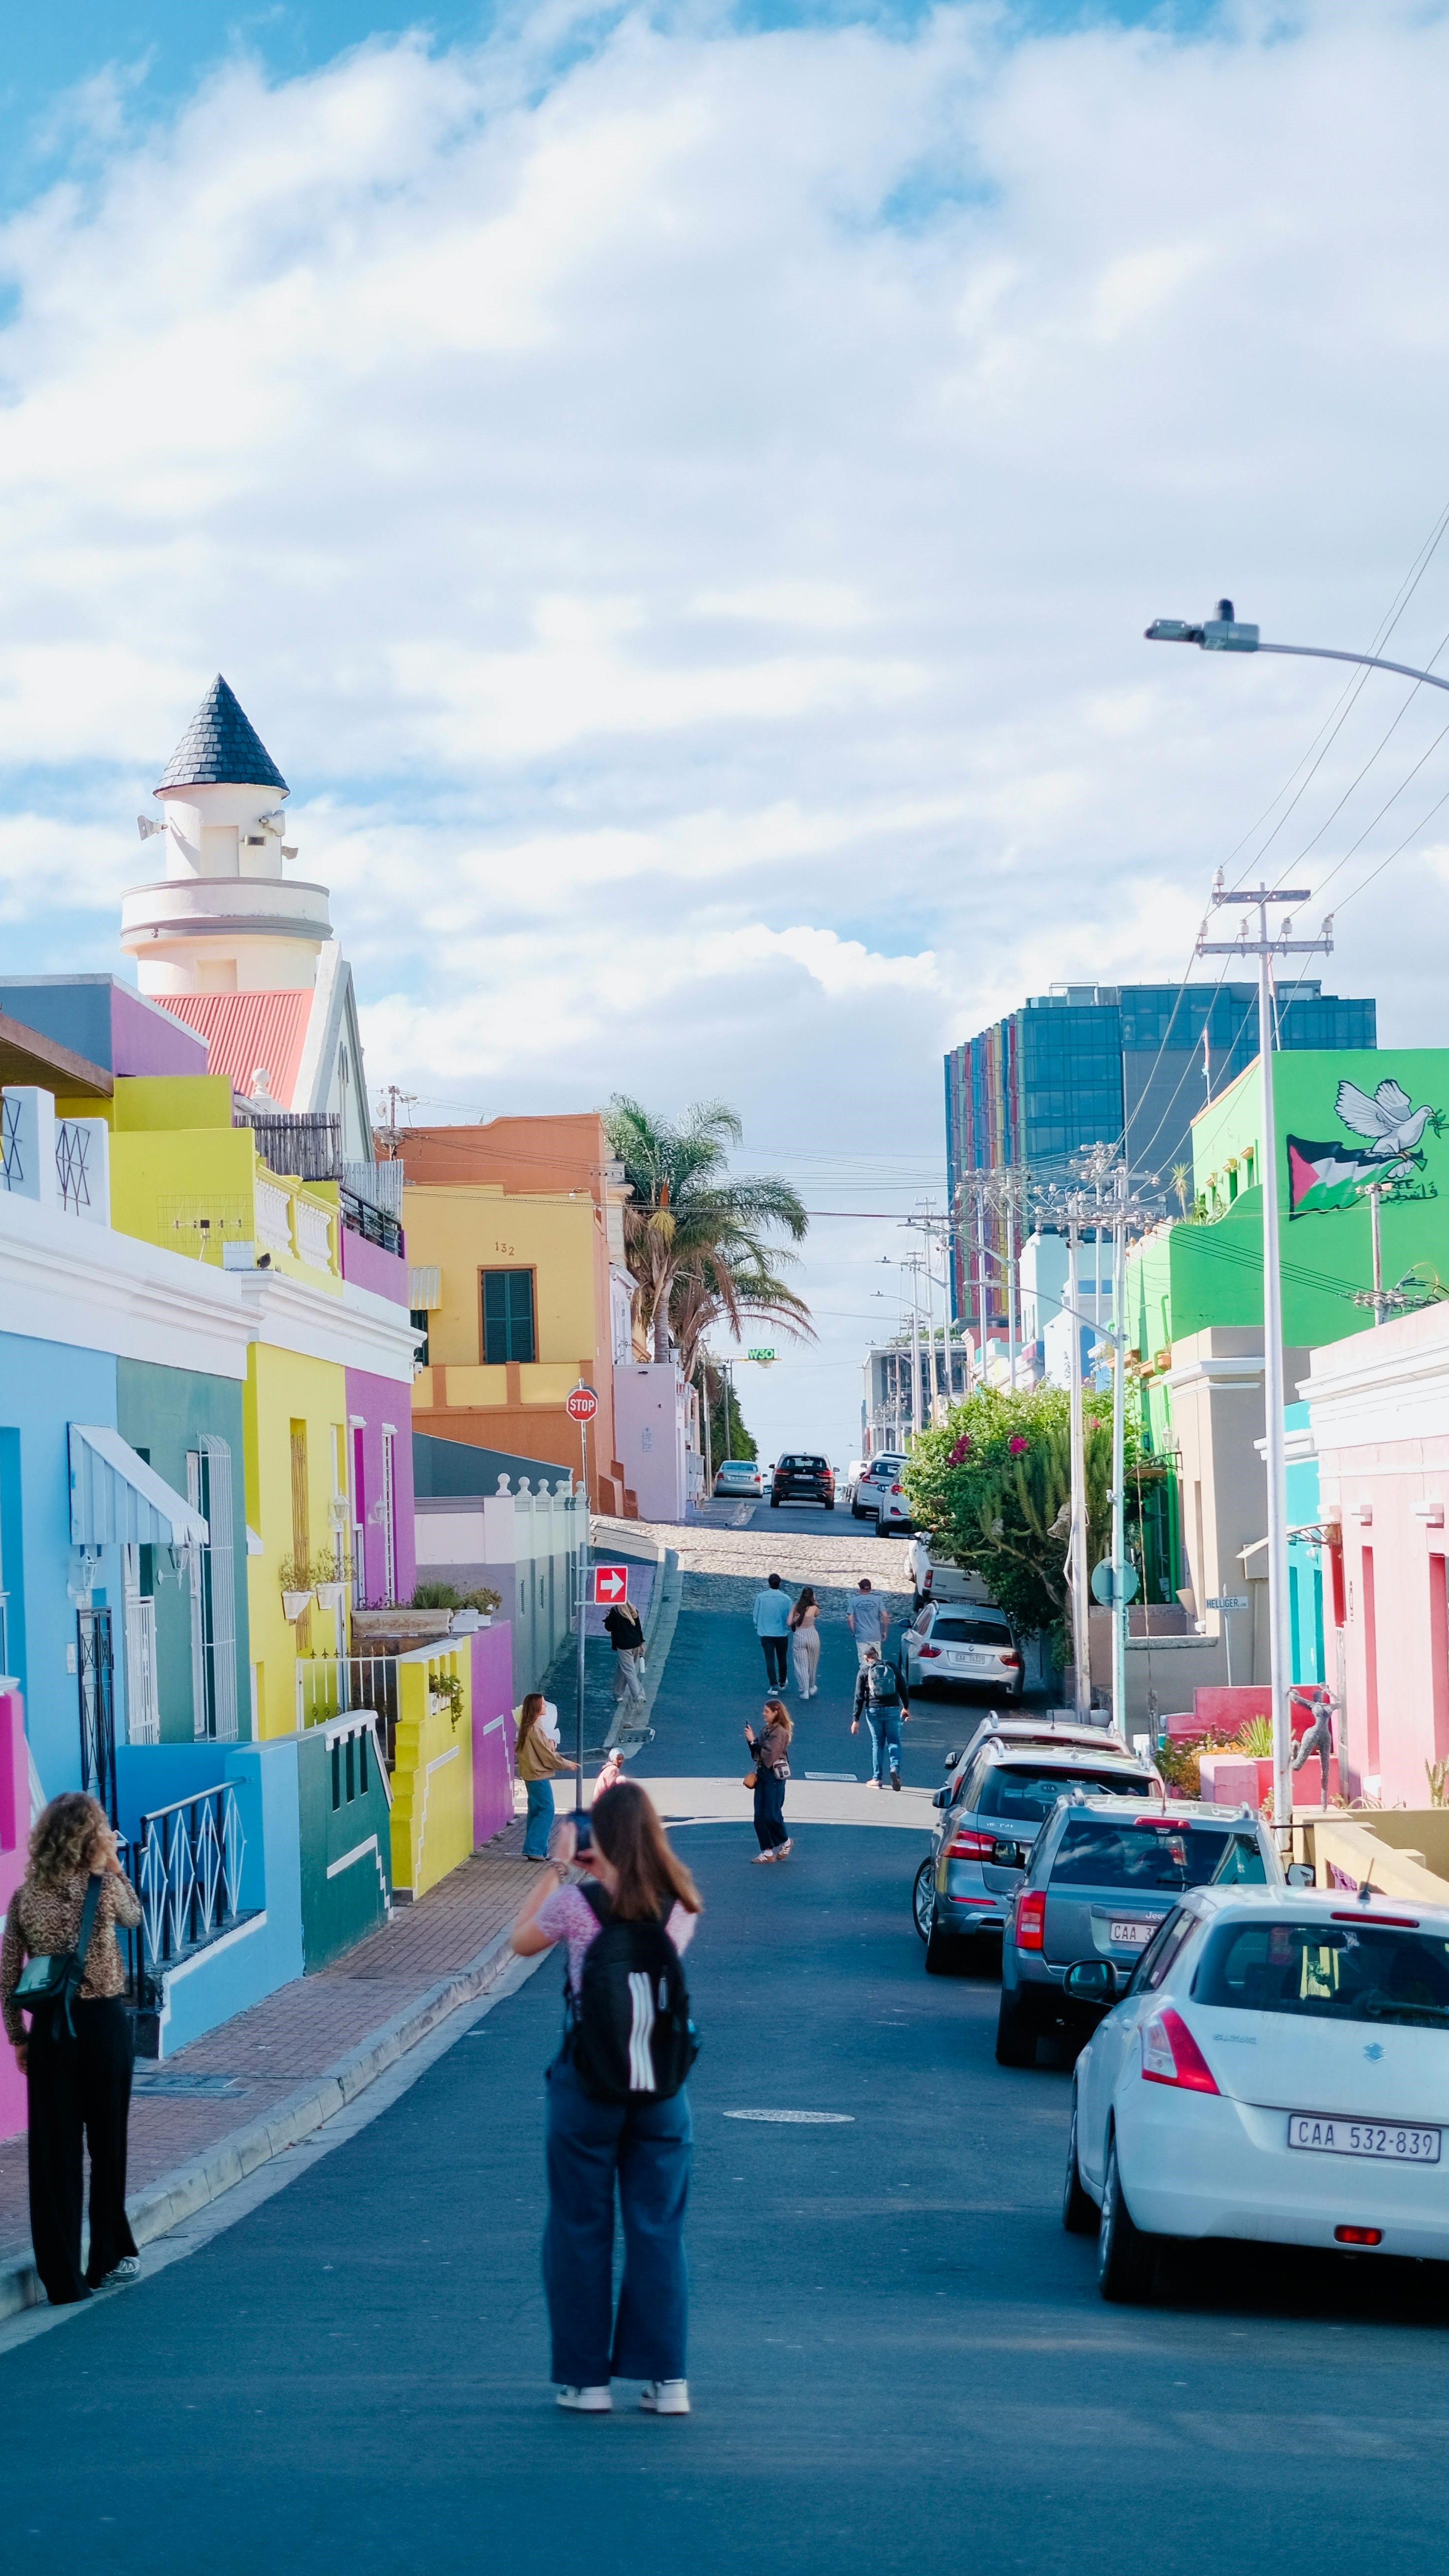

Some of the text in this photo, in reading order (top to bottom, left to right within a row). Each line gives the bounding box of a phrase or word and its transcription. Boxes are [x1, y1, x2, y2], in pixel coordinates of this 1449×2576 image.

[1381, 1179, 1414, 1189] REE
[495, 1241, 514, 1256] 132
[570, 1398, 594, 1412] STOP
[1207, 1599, 1238, 1608] HELLIGER
[1145, 1912, 1165, 1920] Jee
[1115, 1925, 1136, 1940] CAA
[1213, 2034, 1257, 2045] SUZUKI
[1299, 2121, 1433, 2156] CAA 532-839
